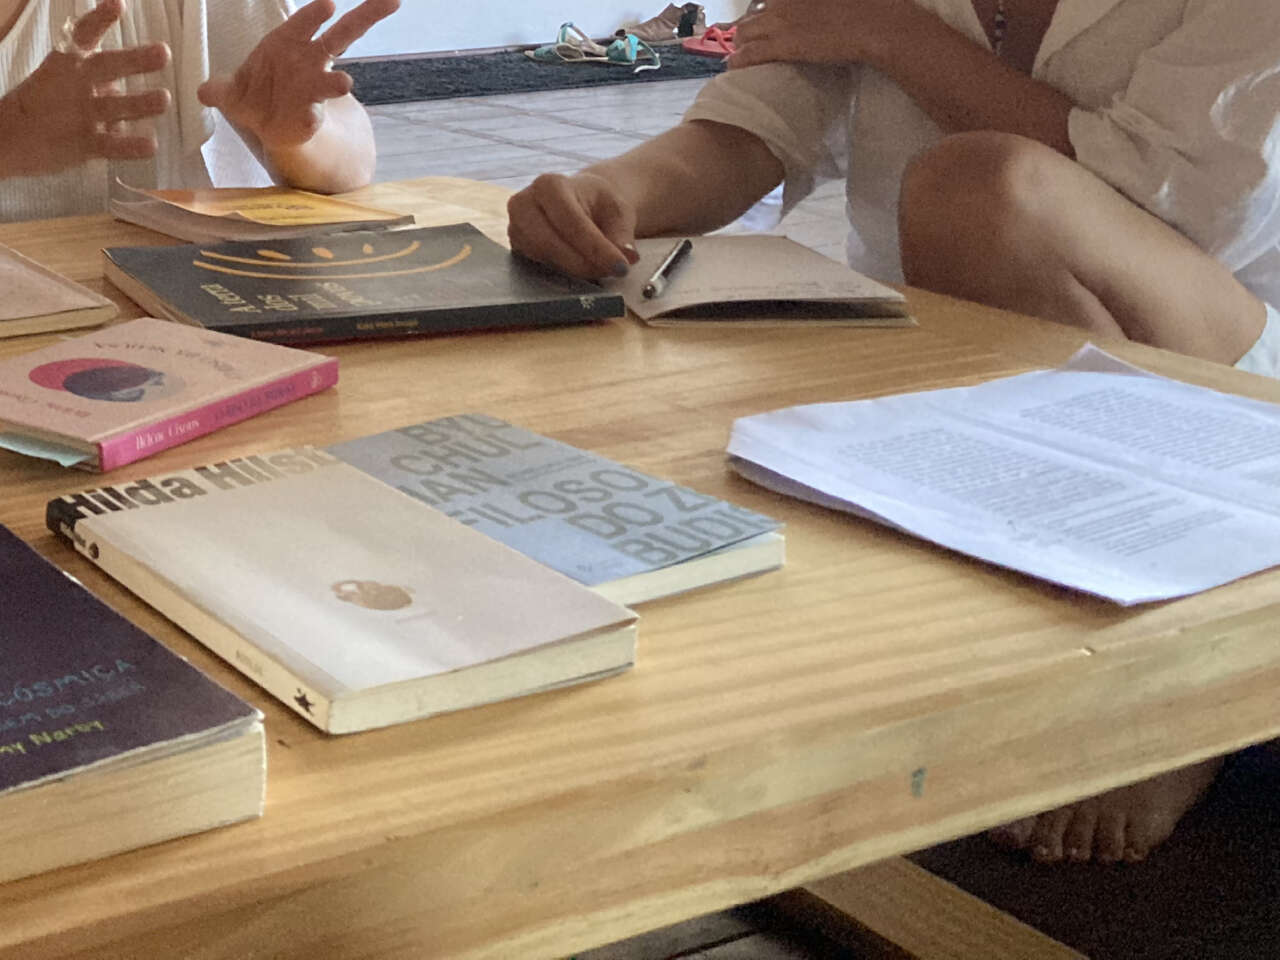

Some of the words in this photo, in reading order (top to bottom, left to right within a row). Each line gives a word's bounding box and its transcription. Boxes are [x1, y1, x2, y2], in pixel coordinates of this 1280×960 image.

[48, 476, 208, 520] Hilda
[194, 444, 342, 491] Hilst
[568, 502, 665, 539] DO
